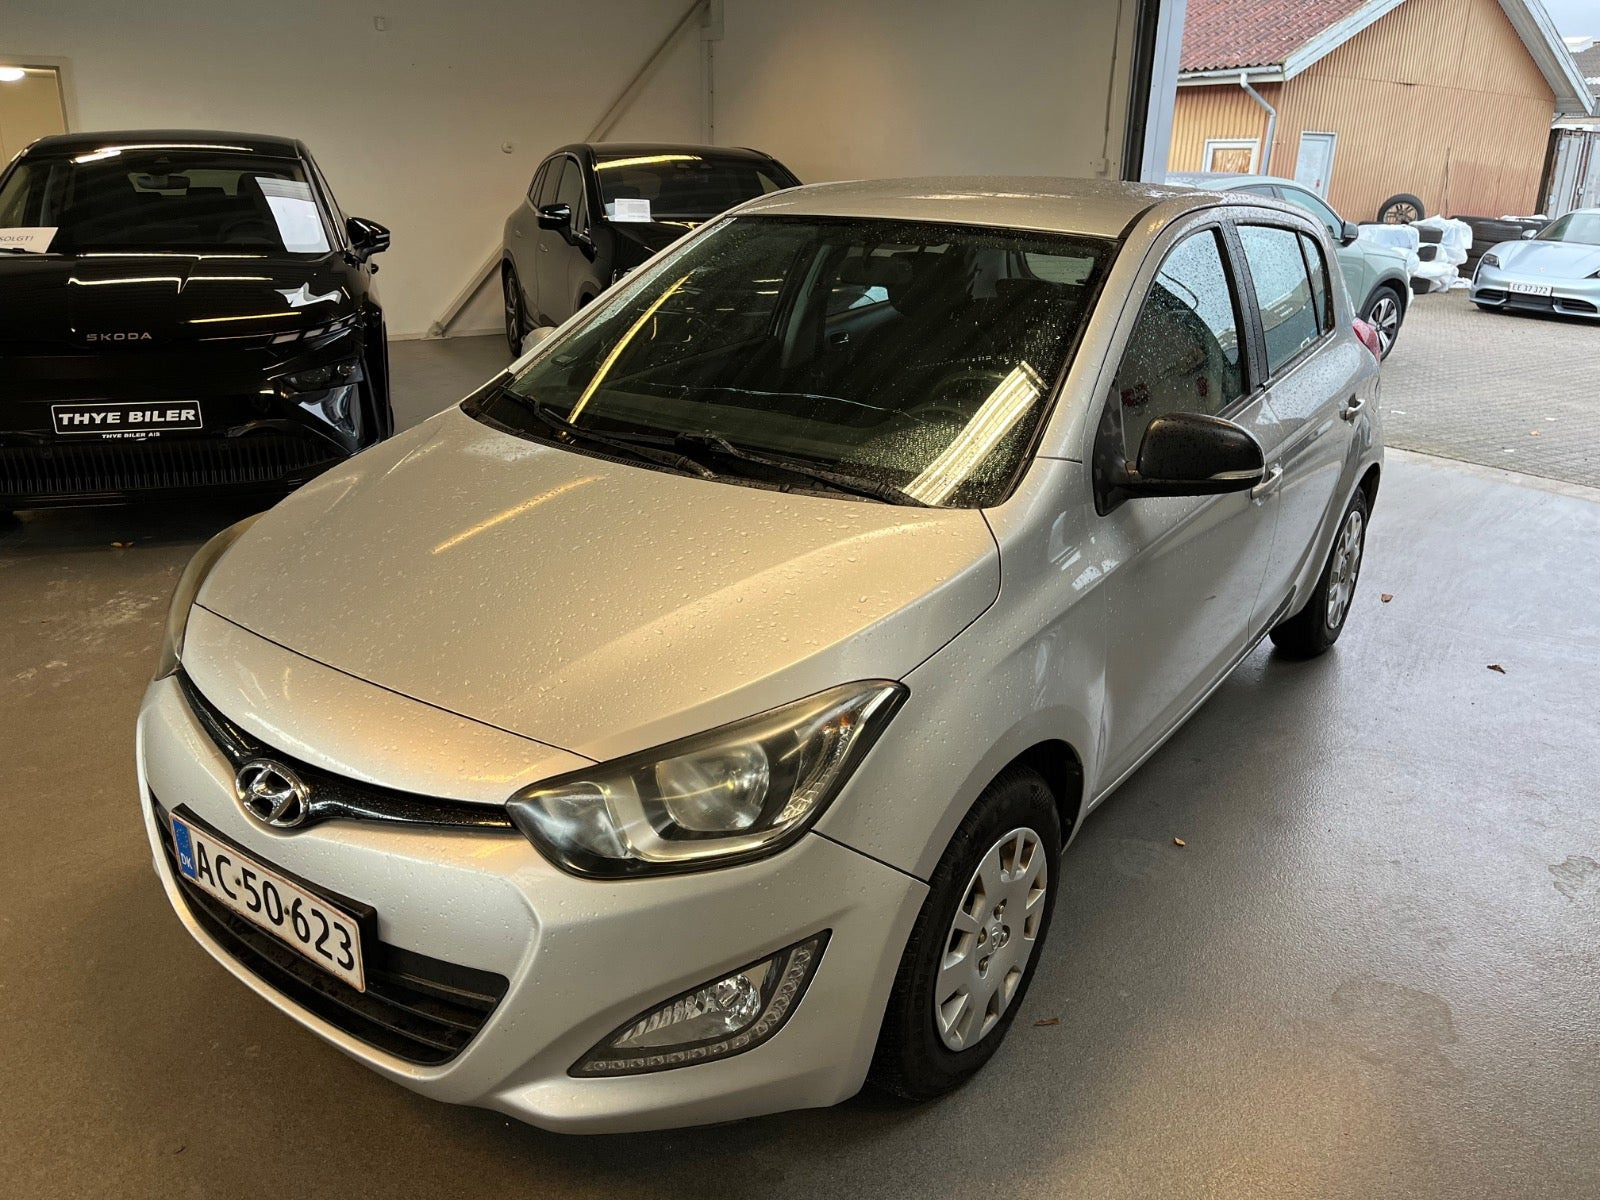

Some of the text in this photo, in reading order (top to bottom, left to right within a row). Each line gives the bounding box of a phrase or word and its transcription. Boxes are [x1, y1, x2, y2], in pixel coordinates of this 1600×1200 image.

[58, 409, 196, 425] THYE BILER
[180, 852, 194, 870] DK
[291, 897, 355, 971] 623
